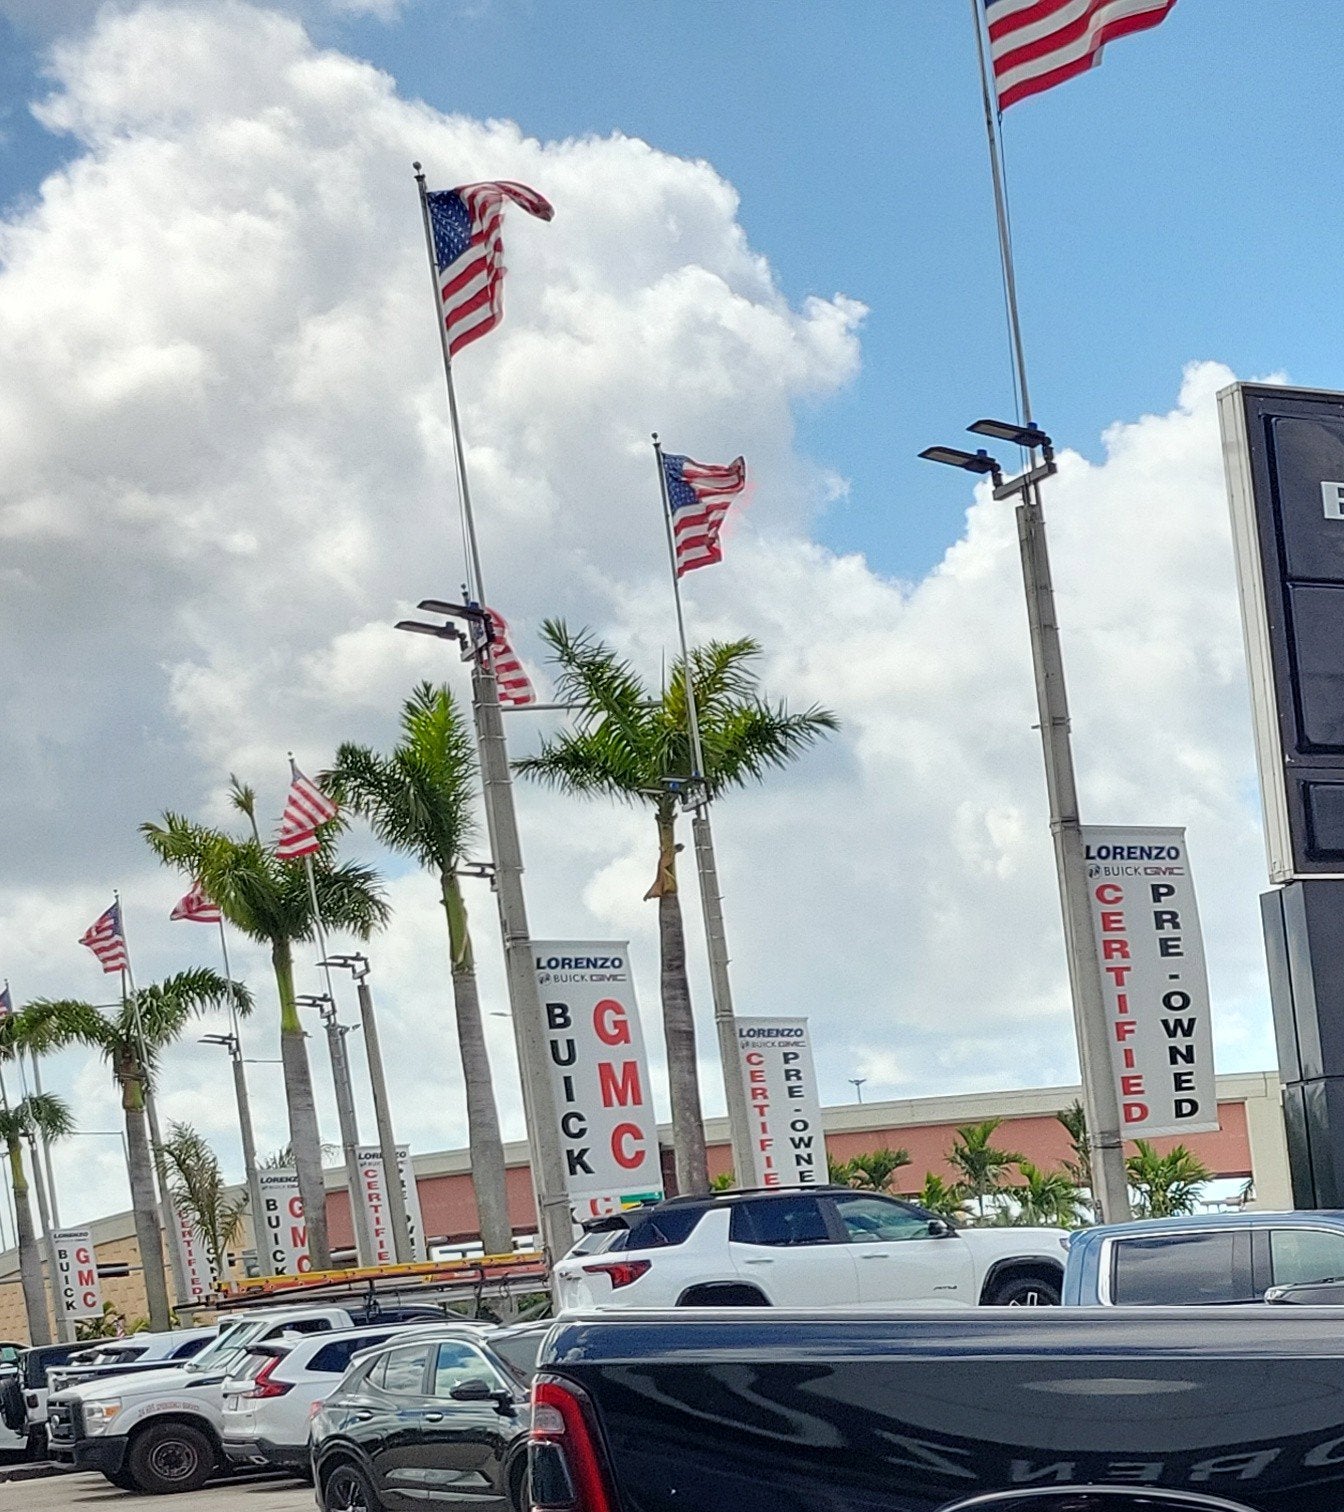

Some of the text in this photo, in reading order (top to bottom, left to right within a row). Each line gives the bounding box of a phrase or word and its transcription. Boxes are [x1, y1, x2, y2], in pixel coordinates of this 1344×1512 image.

[1085, 845, 1180, 861] LORENZO
[1104, 866, 1185, 877] BUICK GMC
[536, 957, 624, 970] LORENZO
[553, 974, 588, 983] BUICK
[1151, 883, 1200, 1119] PRE-OWNED
[738, 1028, 804, 1039] LORENZO
[1095, 883, 1149, 1124] CERTIFIED
[546, 1002, 595, 1176] BUICK
[593, 998, 646, 1170] GMC
[746, 1052, 780, 1188] CERTIFIE
[783, 1052, 815, 1184] PRE-OWNE
[266, 1199, 287, 1276] BUICK
[363, 1169, 390, 1264] CERTIFIE
[58, 1249, 77, 1311] BUICK
[75, 1247, 97, 1308] GMC
